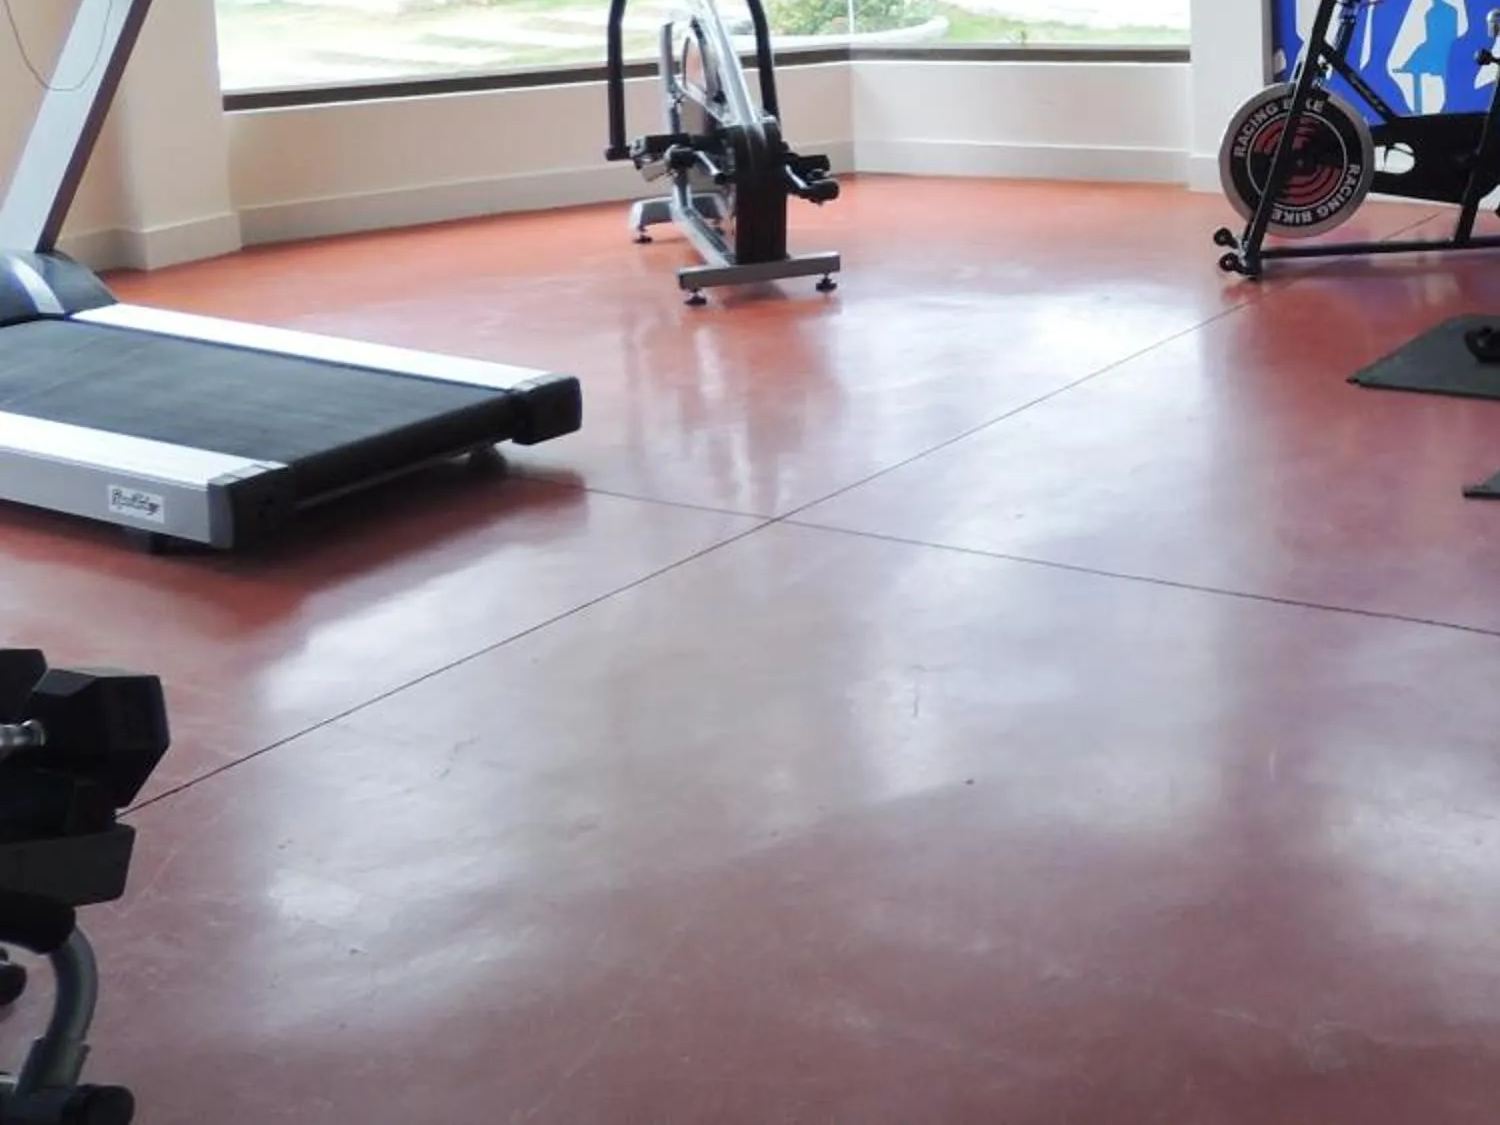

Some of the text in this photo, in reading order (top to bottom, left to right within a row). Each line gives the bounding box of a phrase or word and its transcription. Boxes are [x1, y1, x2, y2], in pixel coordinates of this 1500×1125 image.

[1233, 102, 1278, 157] RACING
[1270, 164, 1361, 224] RACING BIKE
